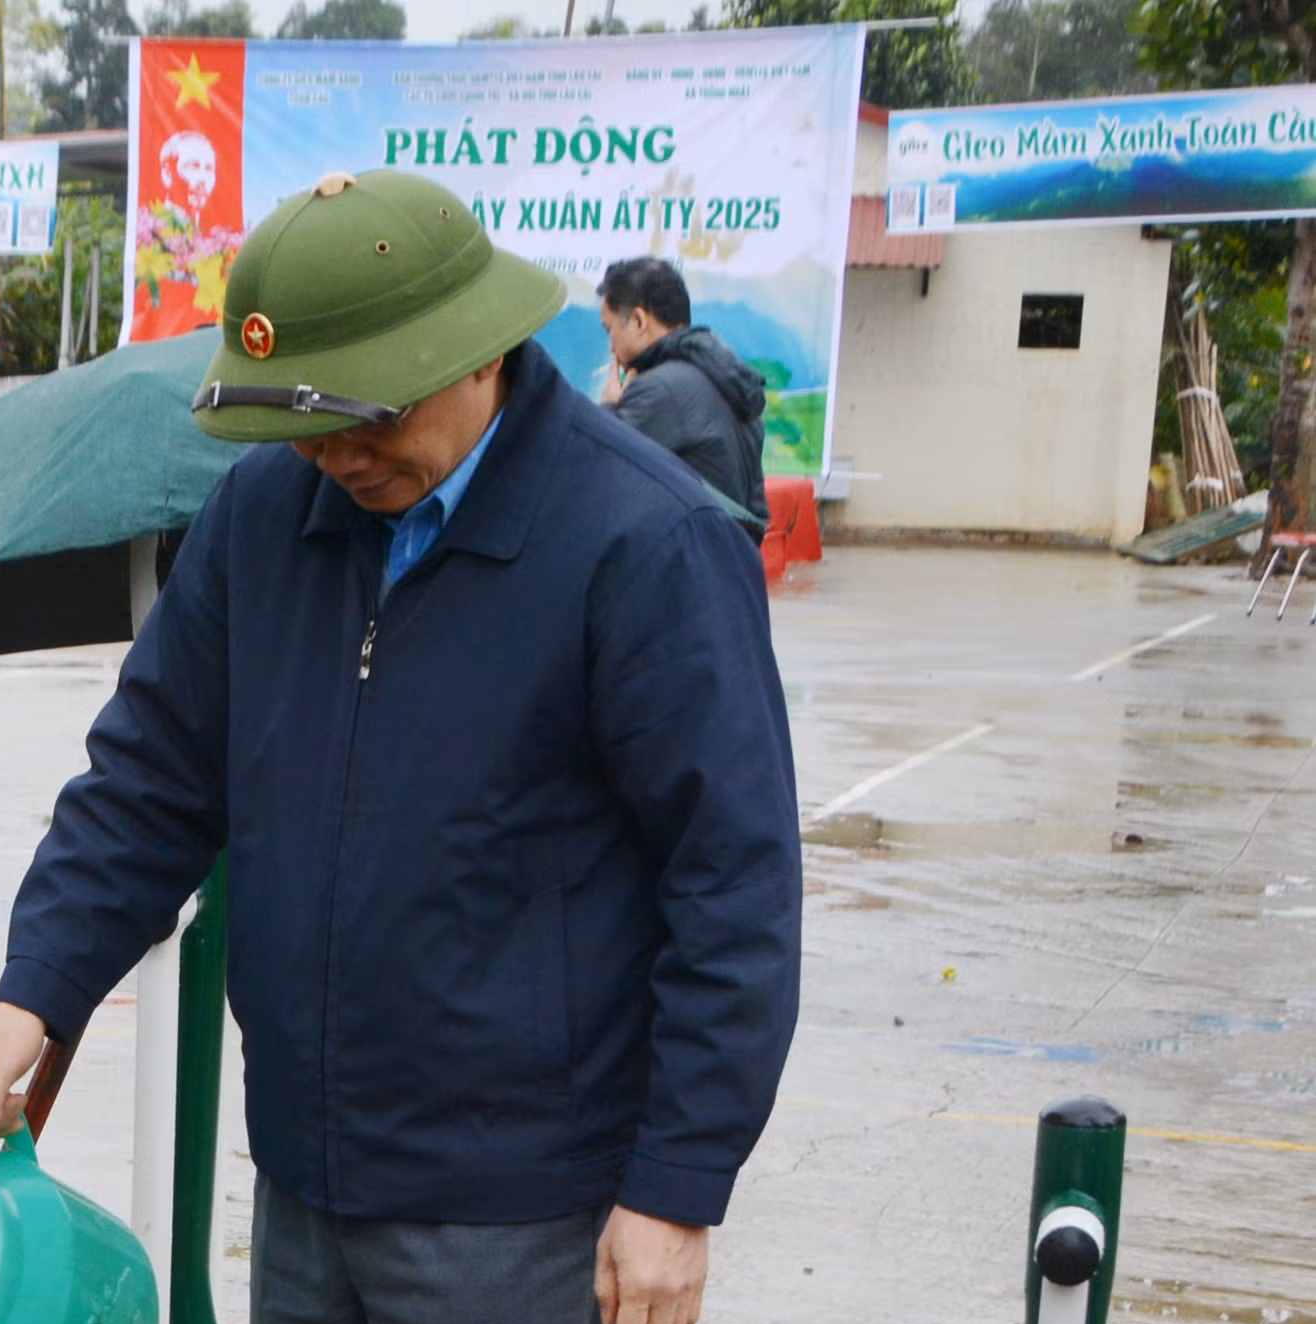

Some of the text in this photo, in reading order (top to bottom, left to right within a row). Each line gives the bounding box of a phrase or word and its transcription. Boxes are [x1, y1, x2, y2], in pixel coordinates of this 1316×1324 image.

[384, 114, 677, 176] PHÁT ĐỘNG
[943, 128, 1006, 163] Gieo
[1017, 117, 1087, 156] Mầm
[1099, 116, 1173, 152] Xanh
[1184, 114, 1257, 147] Toàn
[470, 190, 507, 231] ÂY
[518, 190, 602, 231] XUÂN
[612, 185, 651, 231] ẤT
[705, 196, 781, 232] 2025
